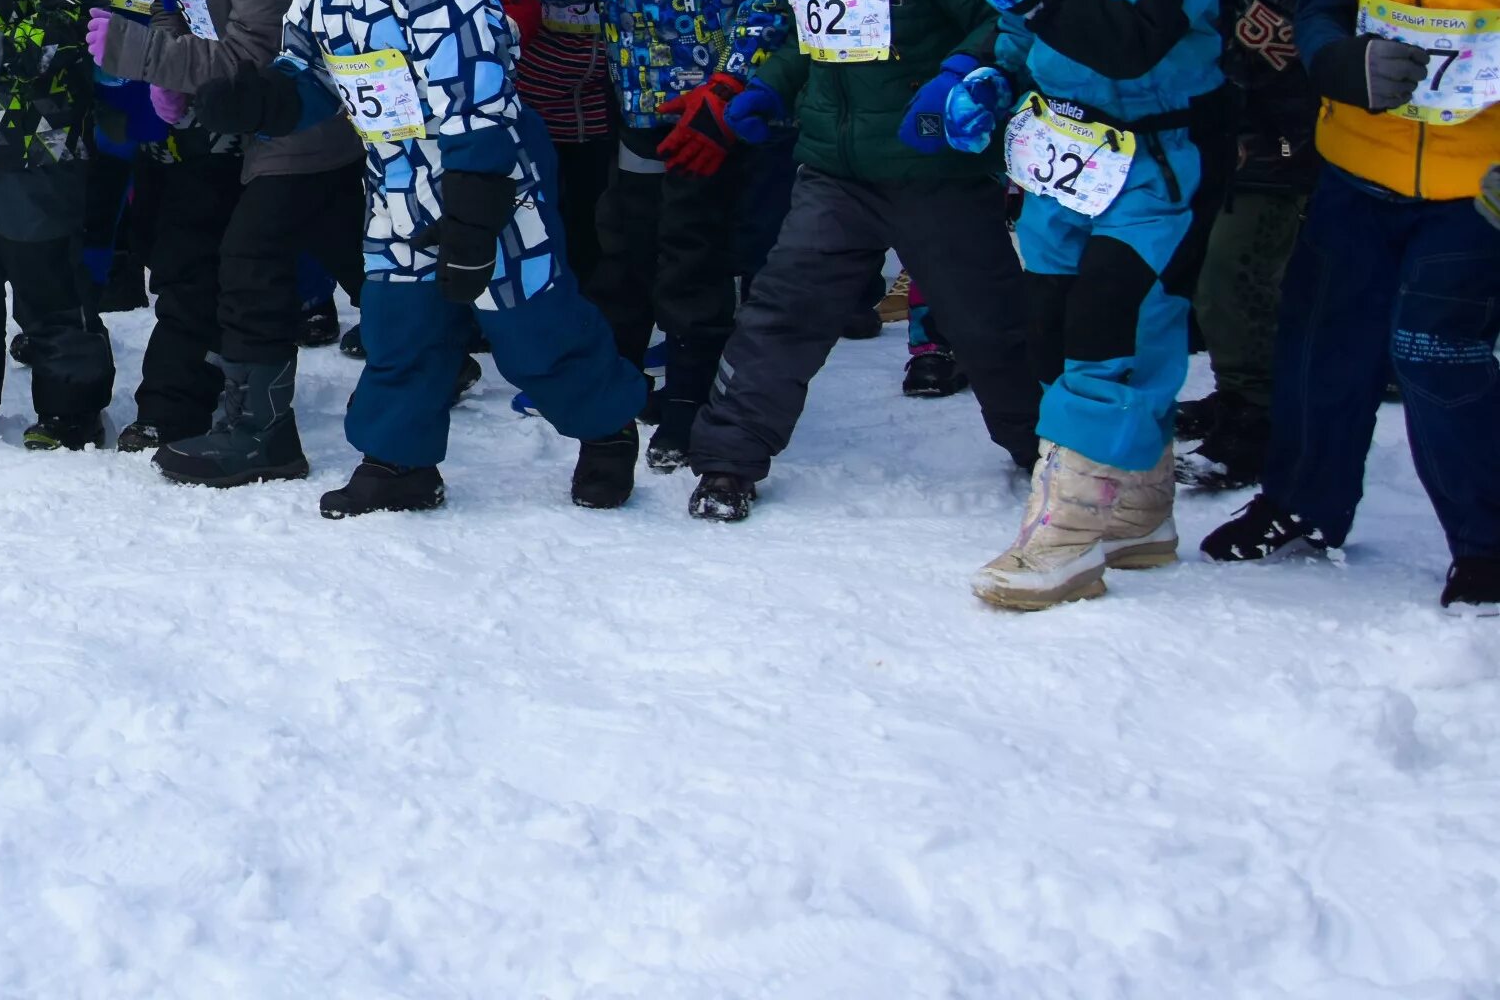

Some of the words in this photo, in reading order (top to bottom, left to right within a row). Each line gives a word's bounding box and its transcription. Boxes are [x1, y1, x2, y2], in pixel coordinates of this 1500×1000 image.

[1391, 10, 1426, 26] БЕЛЫЙ
[1430, 17, 1468, 30] ТРЕЙЛ
[345, 62, 371, 71] ТРЕЙЛ
[1015, 109, 1034, 131] SERIES
[1069, 122, 1094, 139] ТРЕЙЛ
[1034, 143, 1085, 196] 32
